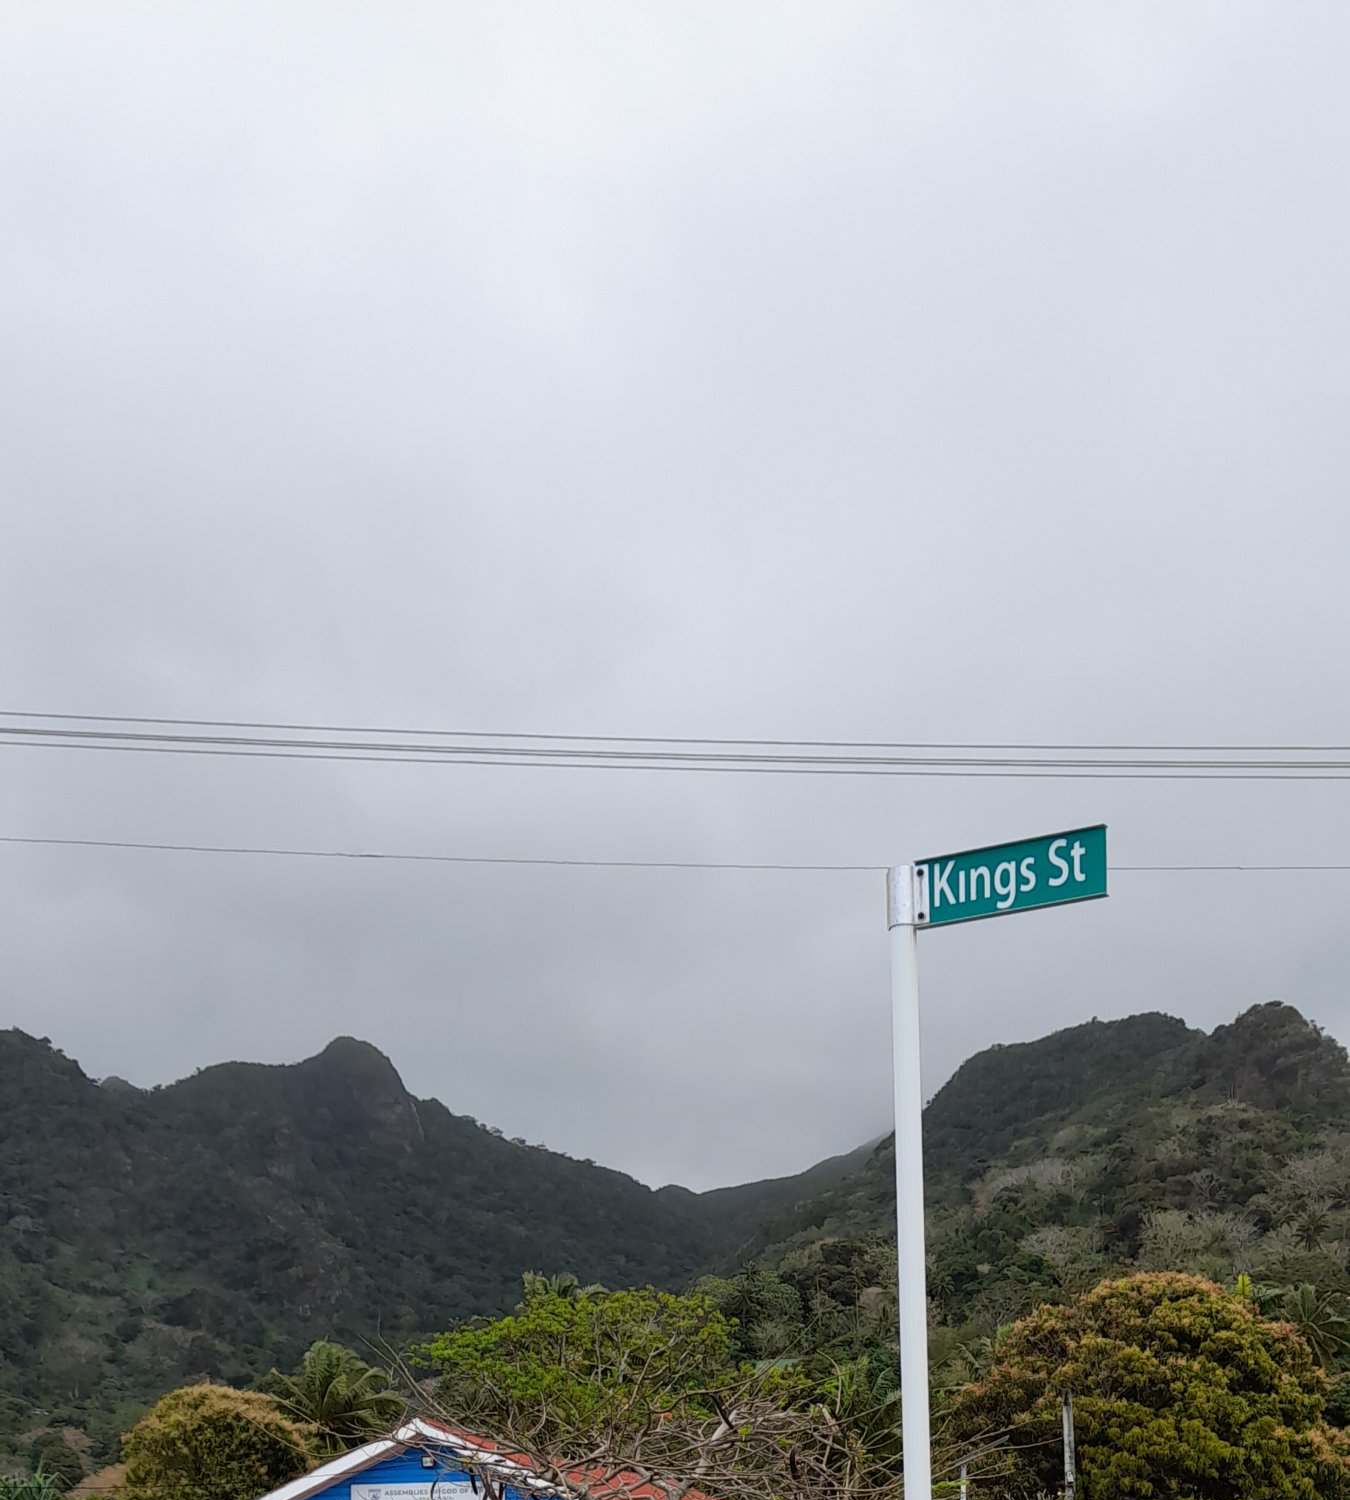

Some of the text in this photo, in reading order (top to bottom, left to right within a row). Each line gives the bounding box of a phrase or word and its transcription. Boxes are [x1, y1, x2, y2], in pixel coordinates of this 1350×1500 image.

[933, 838, 1086, 909] Kings St
[384, 1488, 428, 1496] ASSEMBLIES
[441, 1487, 458, 1495] GOD
